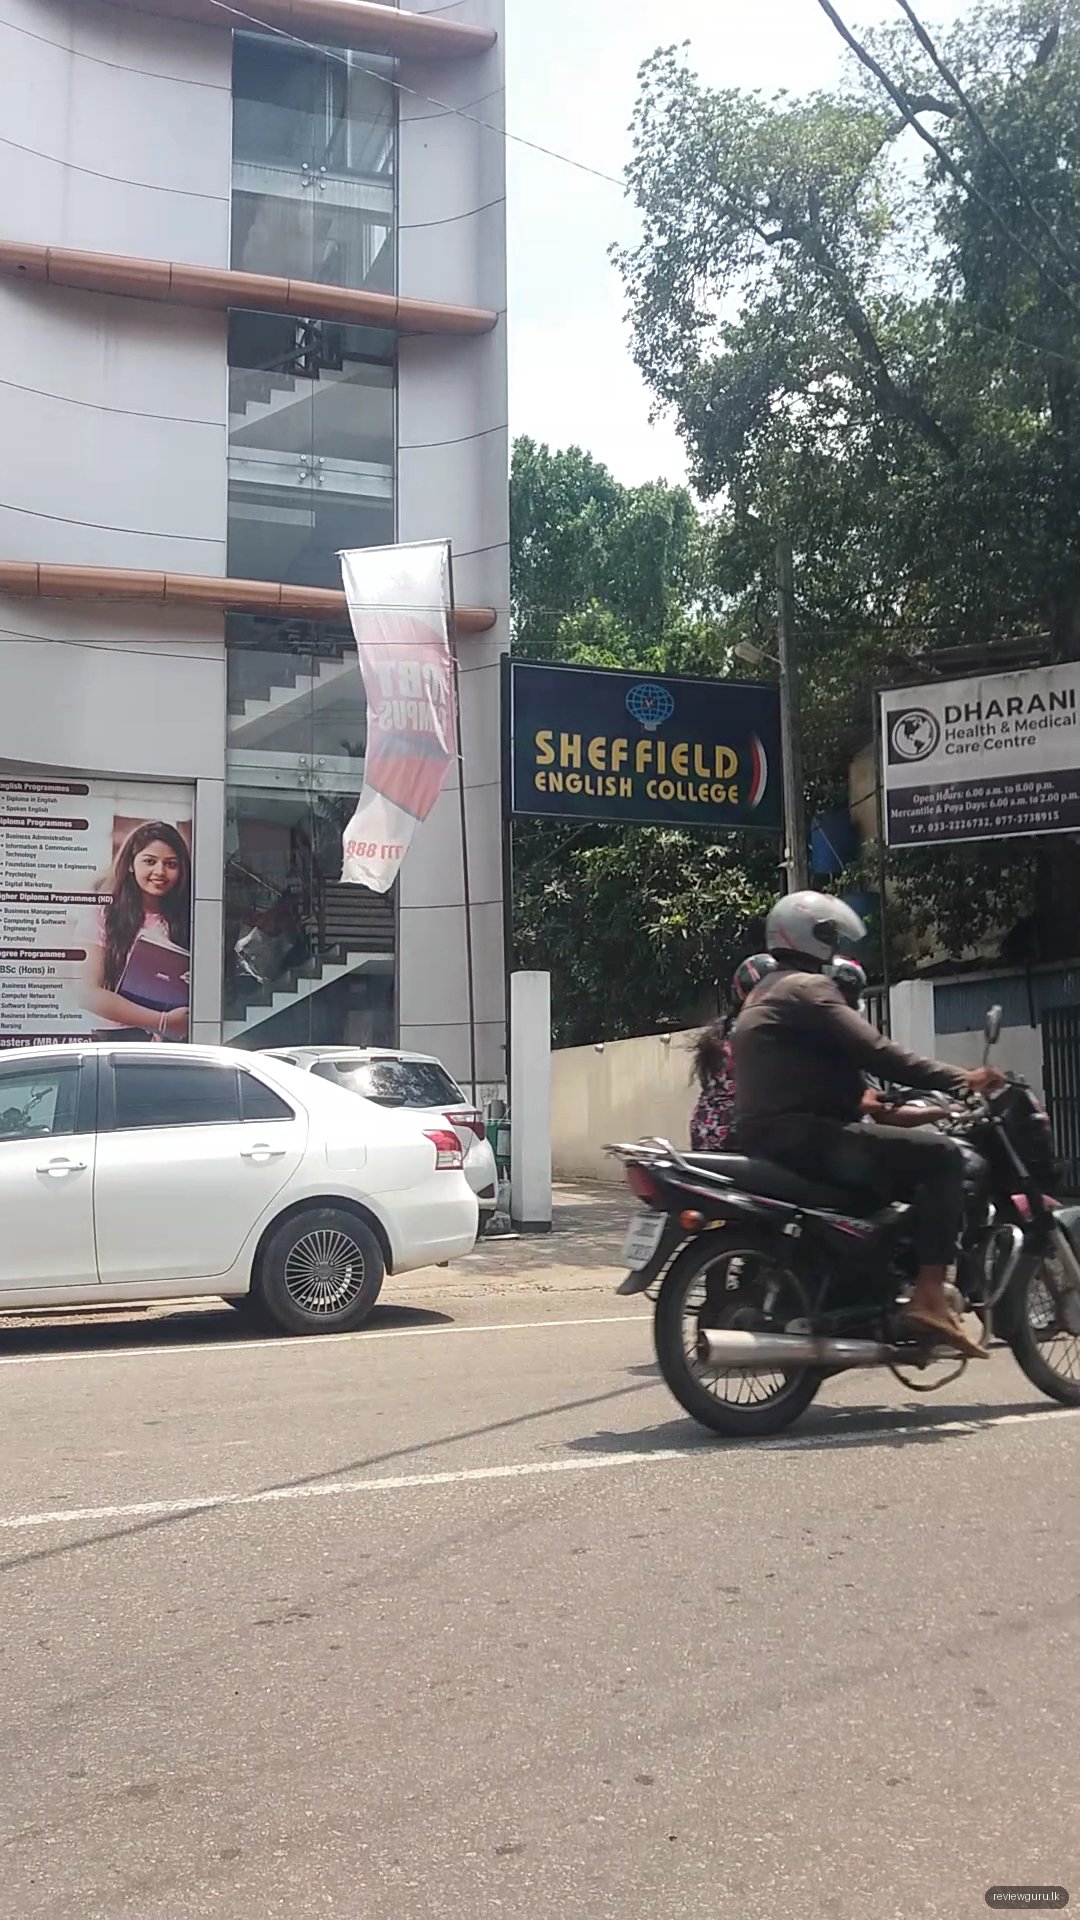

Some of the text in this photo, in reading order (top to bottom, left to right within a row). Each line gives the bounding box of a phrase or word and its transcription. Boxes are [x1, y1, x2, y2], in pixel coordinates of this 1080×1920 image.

[945, 689, 1075, 724] DHARANI
[945, 713, 1075, 740] Health & Medical
[945, 735, 1036, 755] Care Centre
[535, 730, 739, 779] SHEFFIELD
[0, 782, 69, 792] nglish Programmes
[535, 771, 739, 804] ENGLISH COLLEGE
[913, 795, 934, 805] Open
[966, 788, 984, 798] 6.00
[986, 787, 1002, 796] a.m.
[1005, 785, 1014, 794] to
[1016, 782, 1034, 792] 8.00
[1036, 781, 1054, 793] p.m.
[7, 795, 28, 803] Diploma
[891, 806, 934, 818] Mercantile
[936, 805, 942, 813] &
[945, 803, 963, 814] Poya
[966, 801, 988, 812] Days:
[990, 798, 1008, 808] 6.00
[1030, 796, 1038, 804] to
[1041, 793, 1059, 803] 2.00
[0, 817, 72, 827] iploma Programmes
[910, 823, 925, 833] T.P.
[51, 894, 96, 902] Programmes
[19, 966, 45, 974] (Hons)
[0, 1038, 30, 1047] asters
